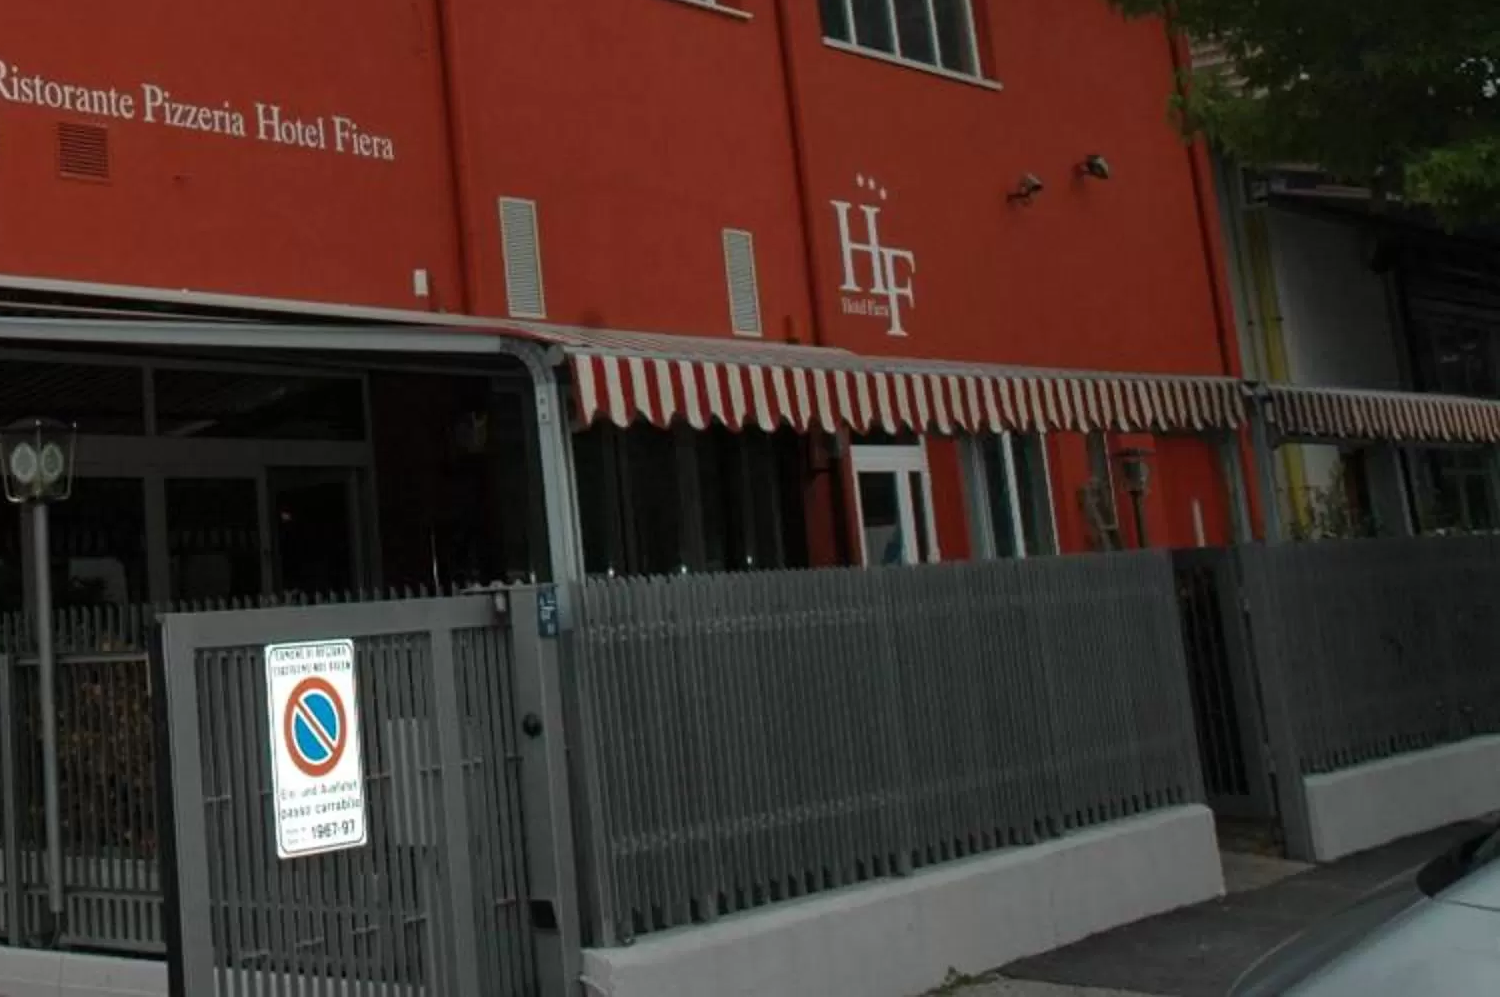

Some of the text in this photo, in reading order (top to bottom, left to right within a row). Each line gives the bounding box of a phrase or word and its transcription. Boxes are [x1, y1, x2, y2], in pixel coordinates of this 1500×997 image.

[141, 83, 245, 138] Pizzeria
[255, 103, 326, 150] Hotel
[332, 116, 395, 161] Fiera
[829, 199, 916, 336] HF
